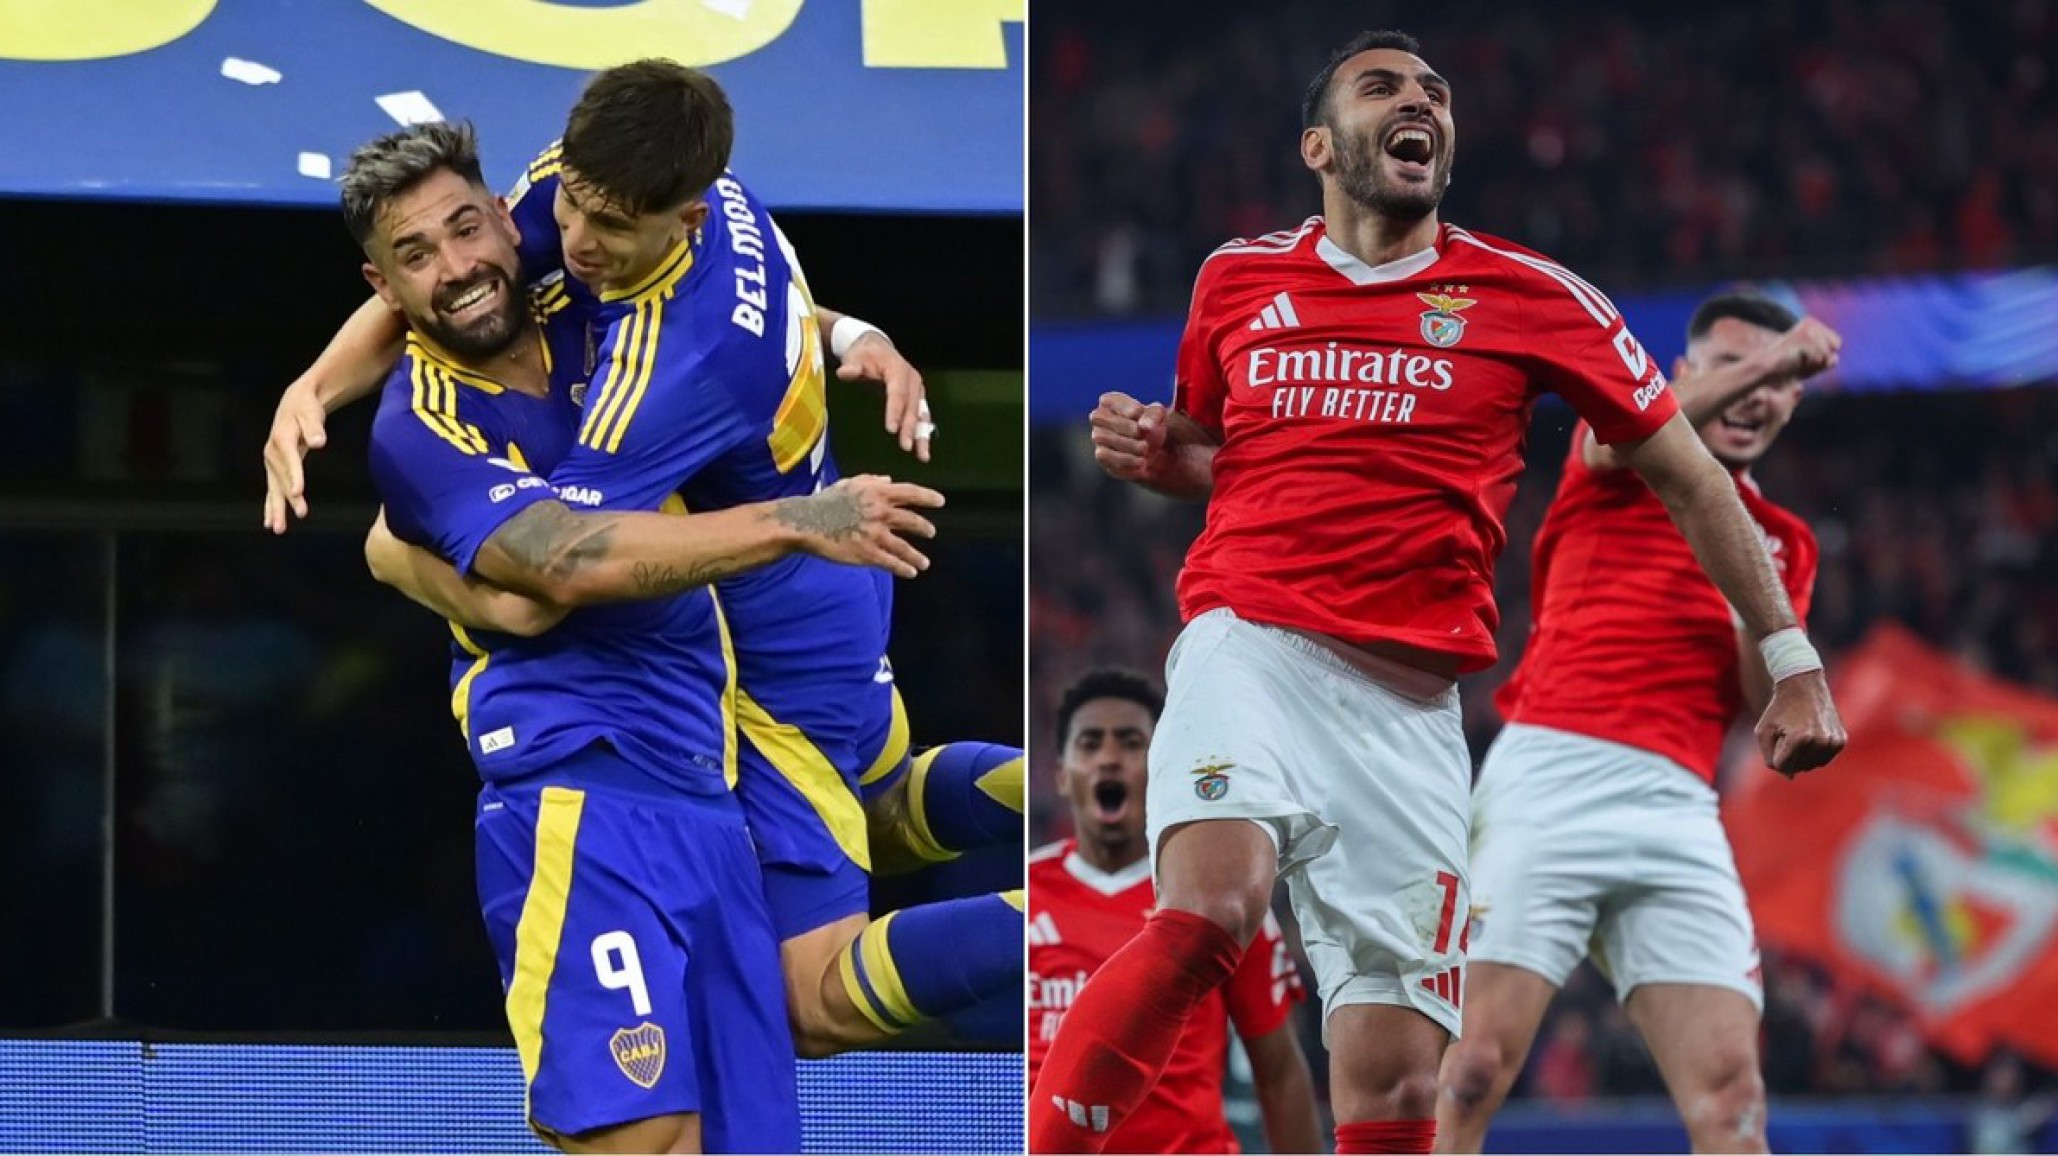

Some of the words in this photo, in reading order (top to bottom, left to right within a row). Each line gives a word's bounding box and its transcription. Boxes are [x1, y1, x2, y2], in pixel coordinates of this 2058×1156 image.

[716, 167, 767, 337] BELMON
[1249, 341, 1454, 391] Emirates
[1271, 386, 1316, 419] FLY
[1321, 387, 1417, 423] BETTER
[1433, 870, 1470, 956] 1
[591, 929, 652, 1017] 9
